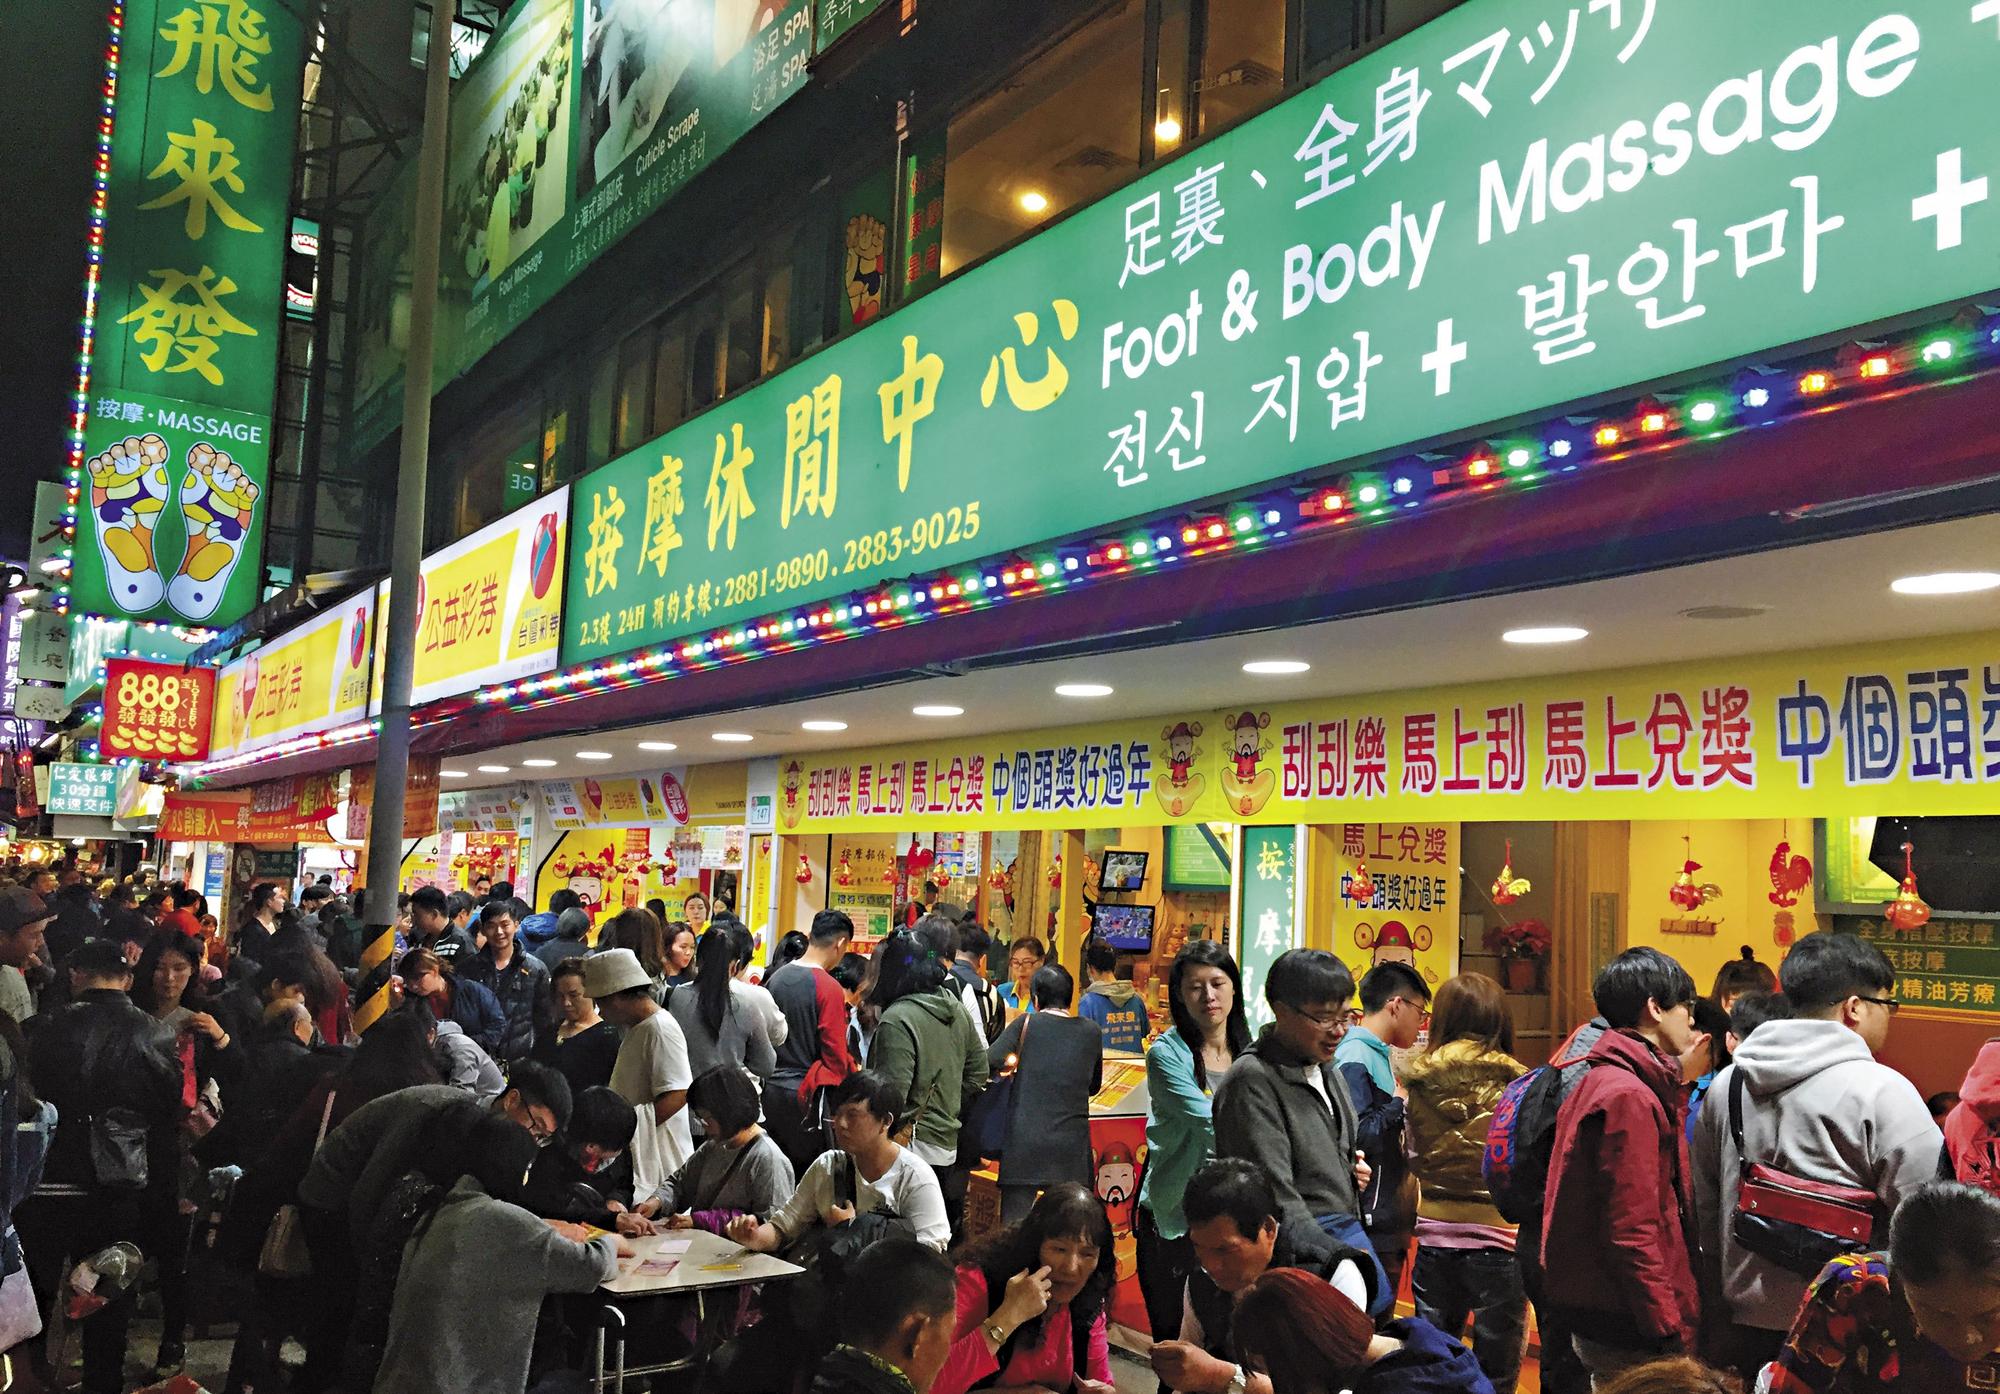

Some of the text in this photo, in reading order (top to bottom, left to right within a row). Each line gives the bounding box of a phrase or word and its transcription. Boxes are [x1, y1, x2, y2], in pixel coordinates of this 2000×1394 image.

[783, 5, 810, 47] SPA
[781, 49, 807, 88] SPA
[635, 138, 667, 177] Cuticle
[667, 107, 700, 148] Scrape
[1102, 14, 1920, 389] Foot & Body Massage
[1103, 391, 1206, 487] 전신
[425, 572, 498, 653] 公益彩券
[617, 604, 646, 636] 24H
[118, 672, 180, 711] 888
[118, 706, 178, 728] 發發發
[188, 679, 200, 730] LOTTERY
[255, 656, 303, 721] 公益彩券
[807, 766, 852, 817] 刮刮樂
[856, 760, 906, 816] 馬上刮
[992, 741, 1152, 811] 中個頭獎好過年
[1281, 715, 1387, 798] 刮刮樂
[1402, 702, 1526, 794] 馬上刮
[1340, 870, 1446, 912] 中頭獎好過年
